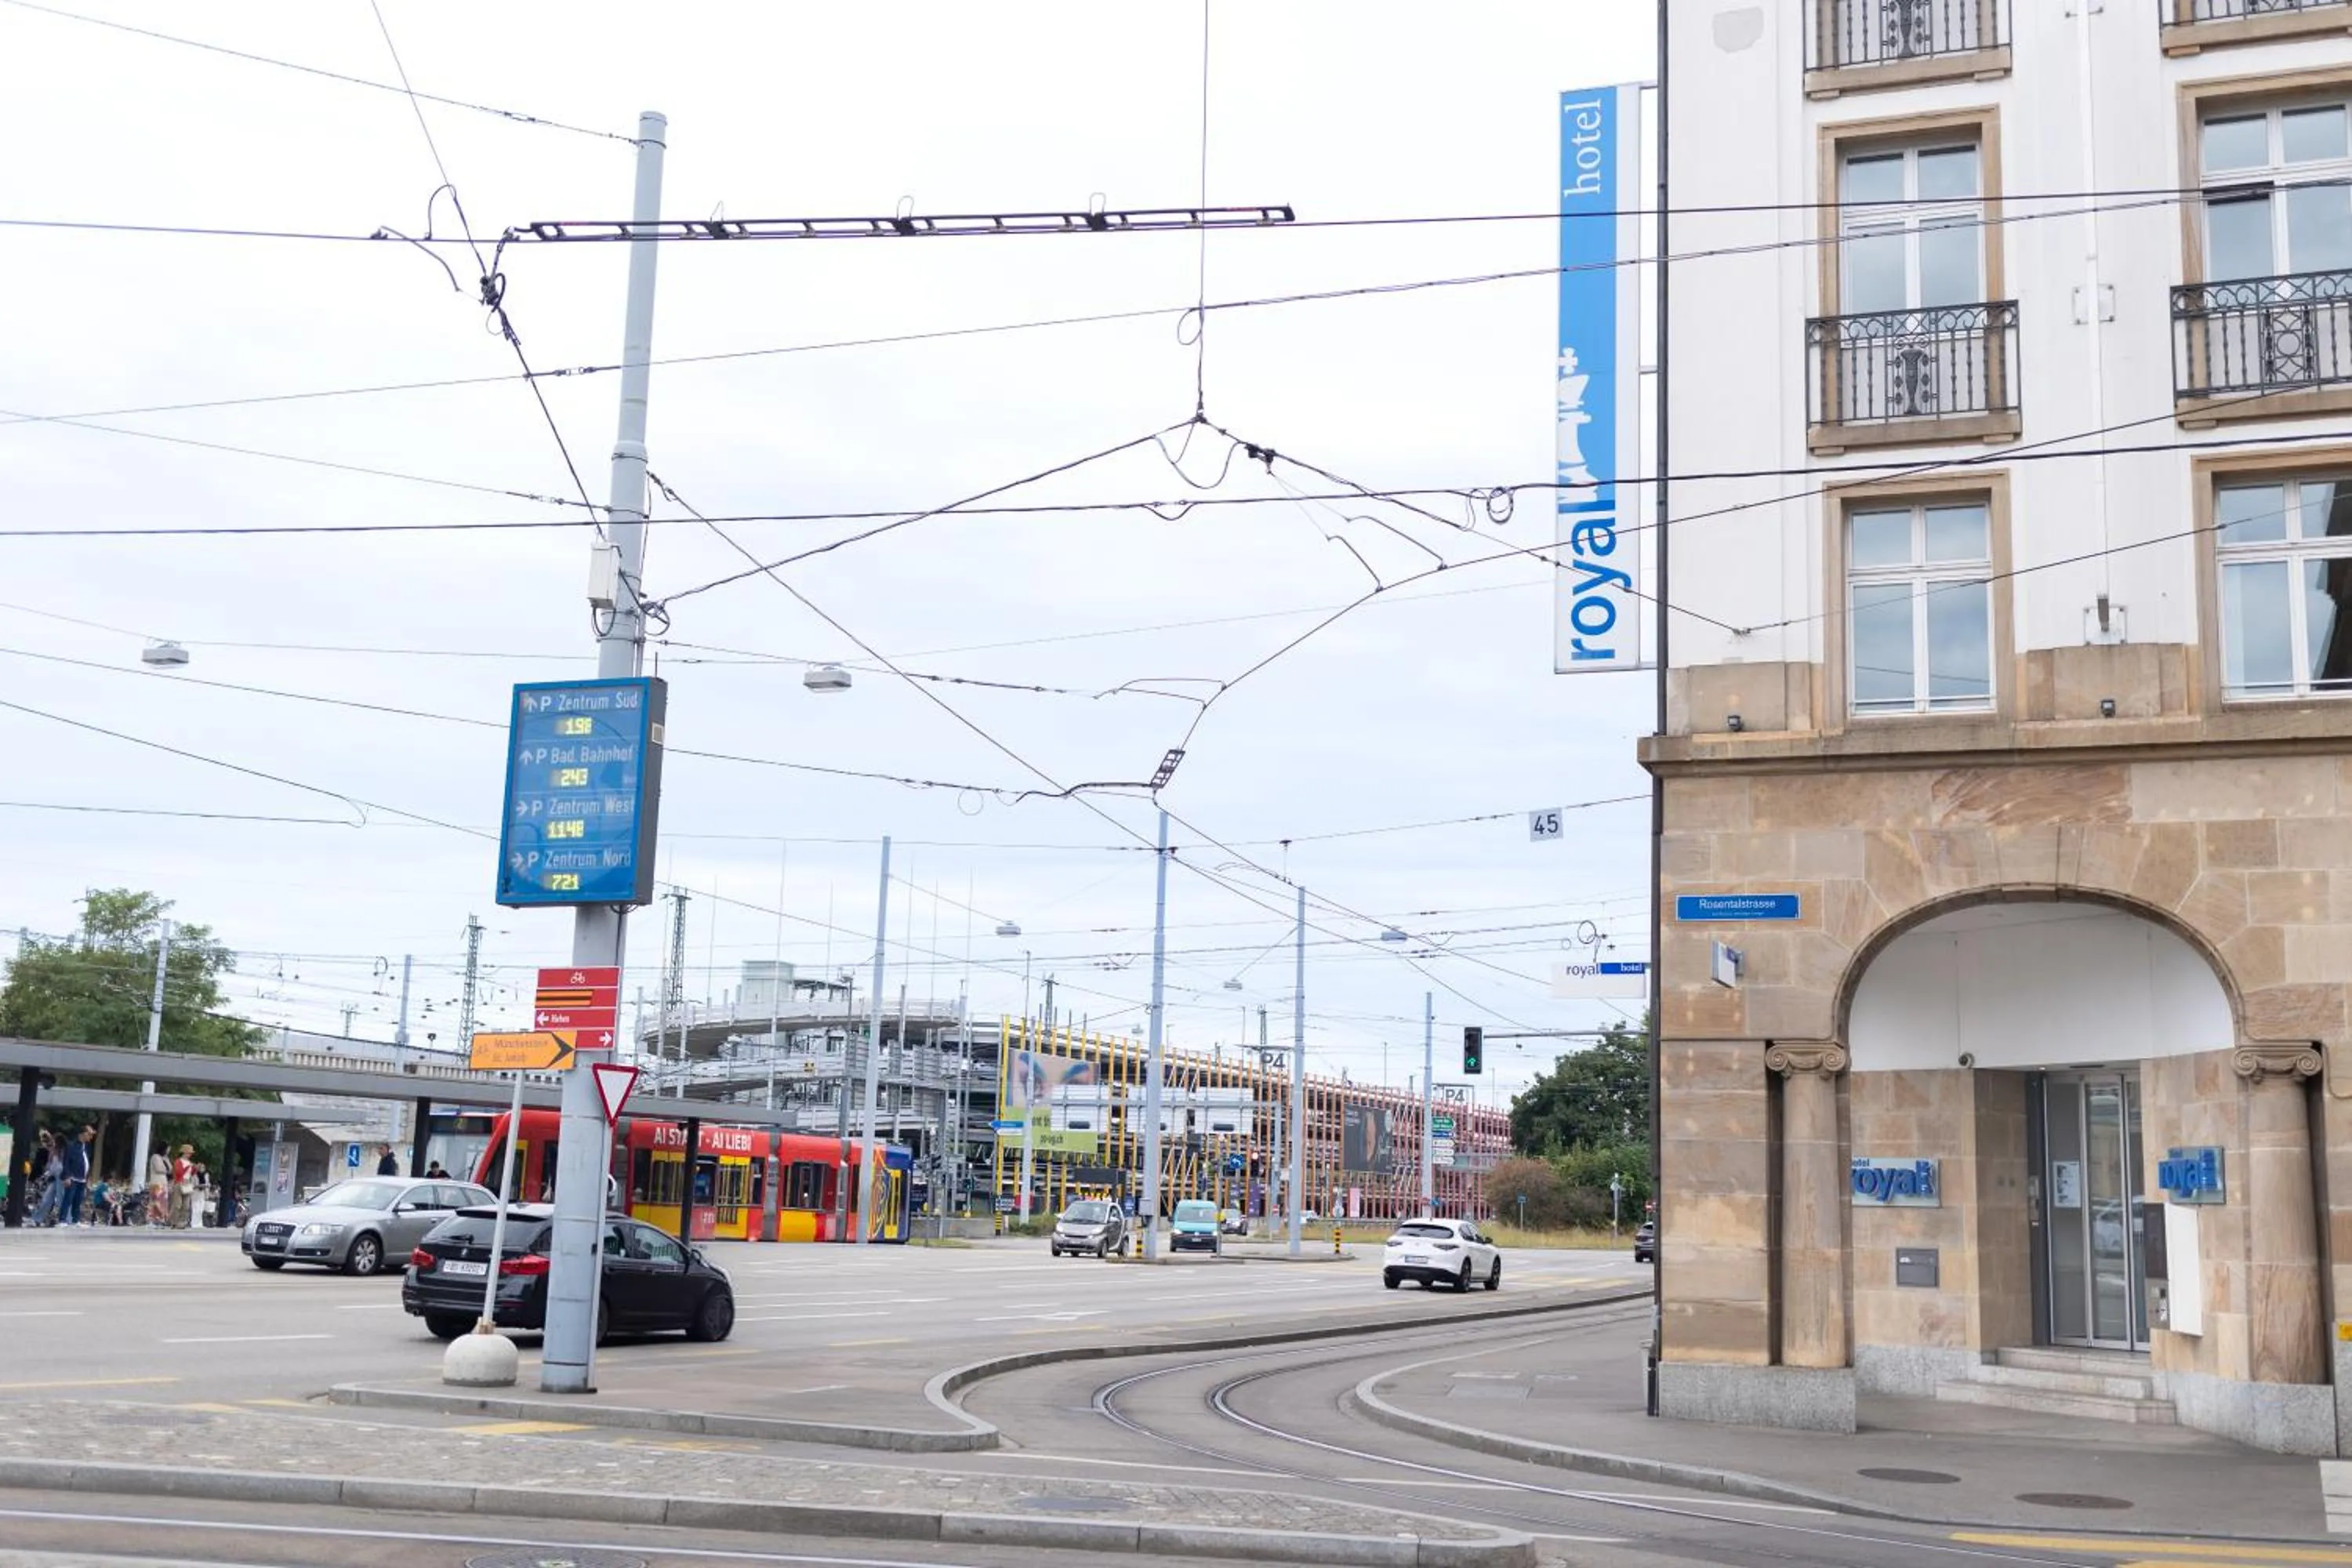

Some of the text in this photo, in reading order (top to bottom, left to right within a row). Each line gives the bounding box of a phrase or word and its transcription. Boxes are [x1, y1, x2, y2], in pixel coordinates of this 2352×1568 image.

[1563, 98, 1602, 198] hotel
[1558, 500, 1632, 660] royal
[557, 693, 609, 712] Zentrum
[581, 744, 633, 764] Bahnhof
[560, 768, 588, 786] 243
[549, 797, 600, 816] Zentrum
[604, 794, 634, 814] West
[1534, 814, 1558, 835] 45
[544, 848, 596, 868] Zentrum
[602, 845, 631, 867] Nord
[551, 873, 579, 891] 721
[1698, 898, 1776, 910] Rosentalstrasse
[1566, 962, 1643, 979] royal hotel
[1261, 1052, 1286, 1069] P4
[1445, 1089, 1465, 1102] P4
